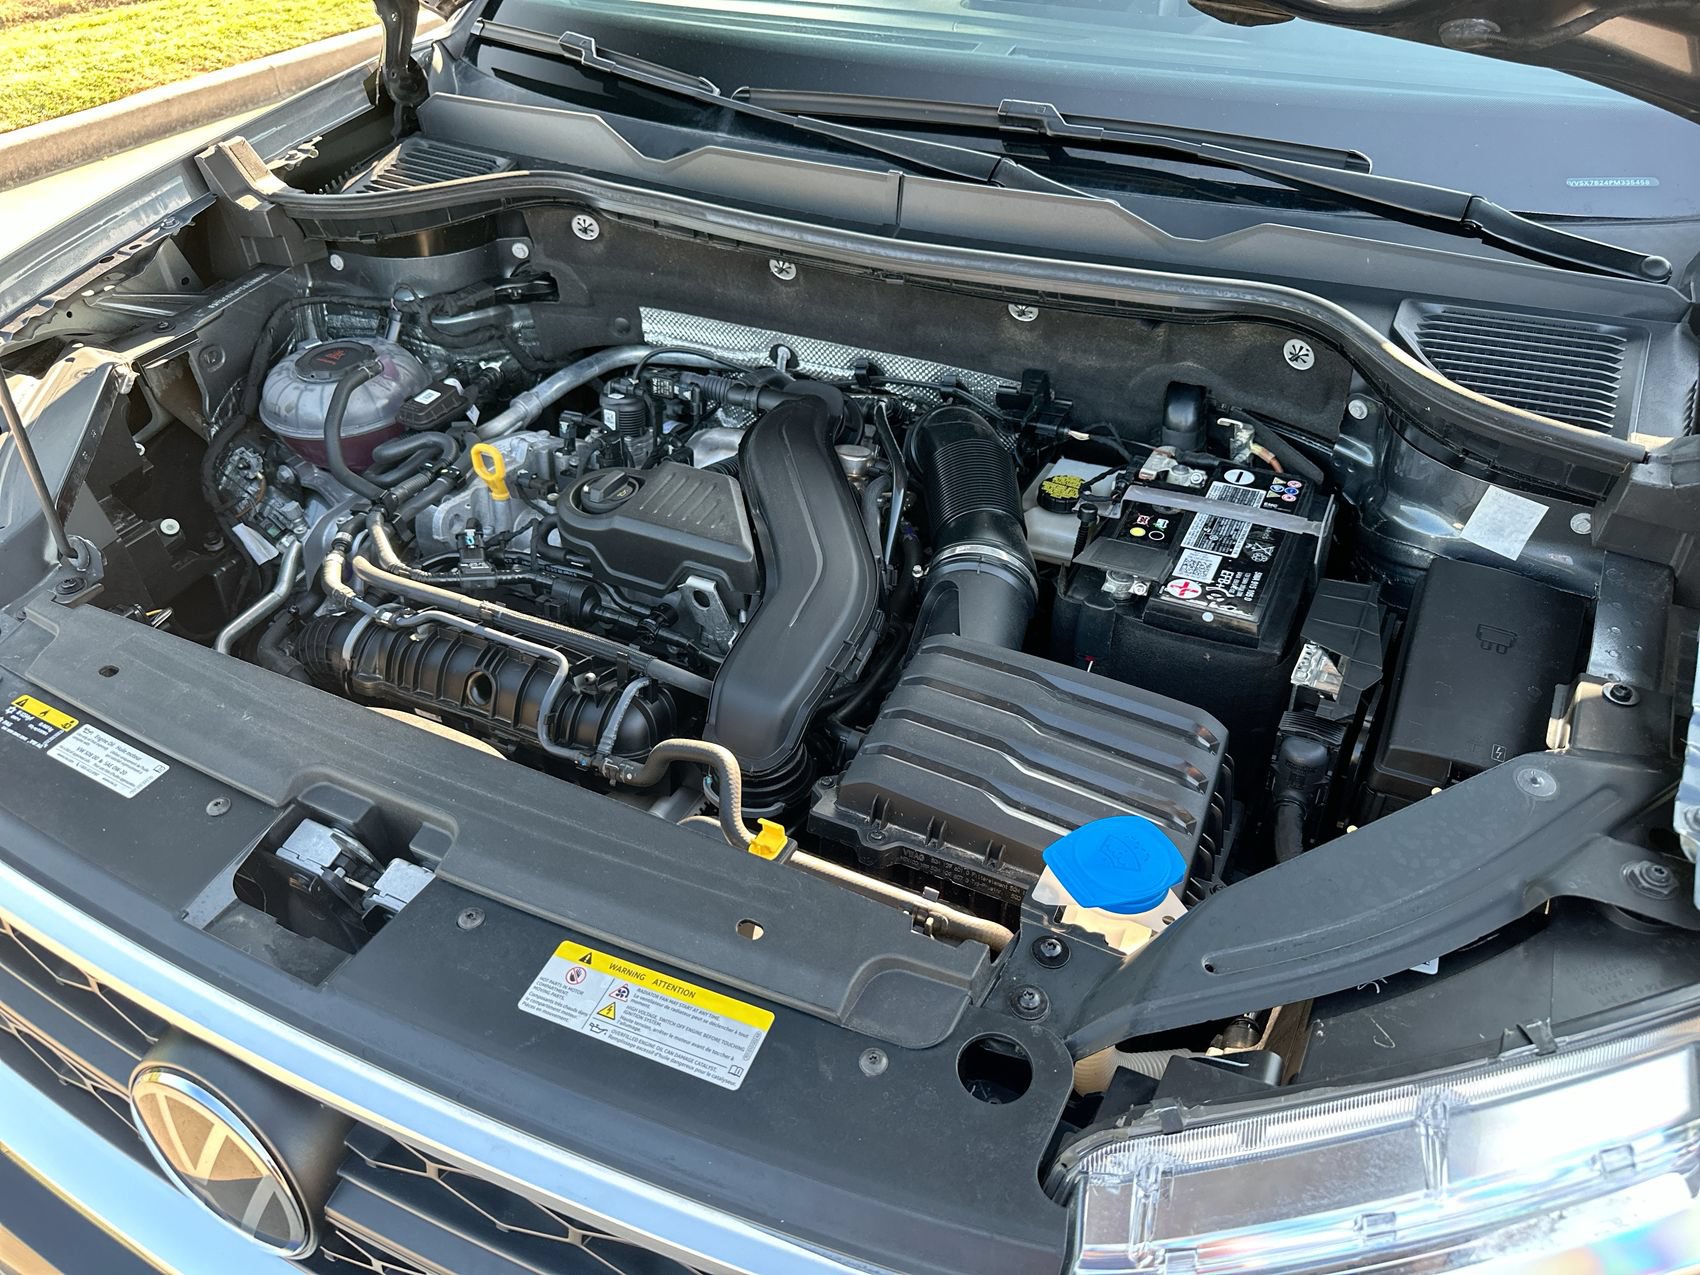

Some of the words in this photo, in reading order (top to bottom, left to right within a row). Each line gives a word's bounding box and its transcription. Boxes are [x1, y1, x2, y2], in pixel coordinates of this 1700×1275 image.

[548, 980, 563, 988] PARTS
[568, 987, 584, 996] MOTOR
[608, 963, 647, 981] WARNING
[652, 978, 697, 999] ATTENTION
[637, 988, 660, 999] RADIATOR
[679, 1003, 693, 1011] START
[639, 995, 665, 1008] ventilateur
[670, 1007, 692, 1018] radiateur
[623, 1010, 644, 1020] IGNITION
[658, 1017, 677, 1027] SWITCH
[685, 1027, 703, 1037] ENGINE
[703, 1033, 721, 1043] BEFORE
[721, 1040, 746, 1052] TOUCHING
[610, 1029, 639, 1043] OVERFILLED
[638, 1039, 657, 1049] ENGINE
[674, 1053, 695, 1064] DAMAGE
